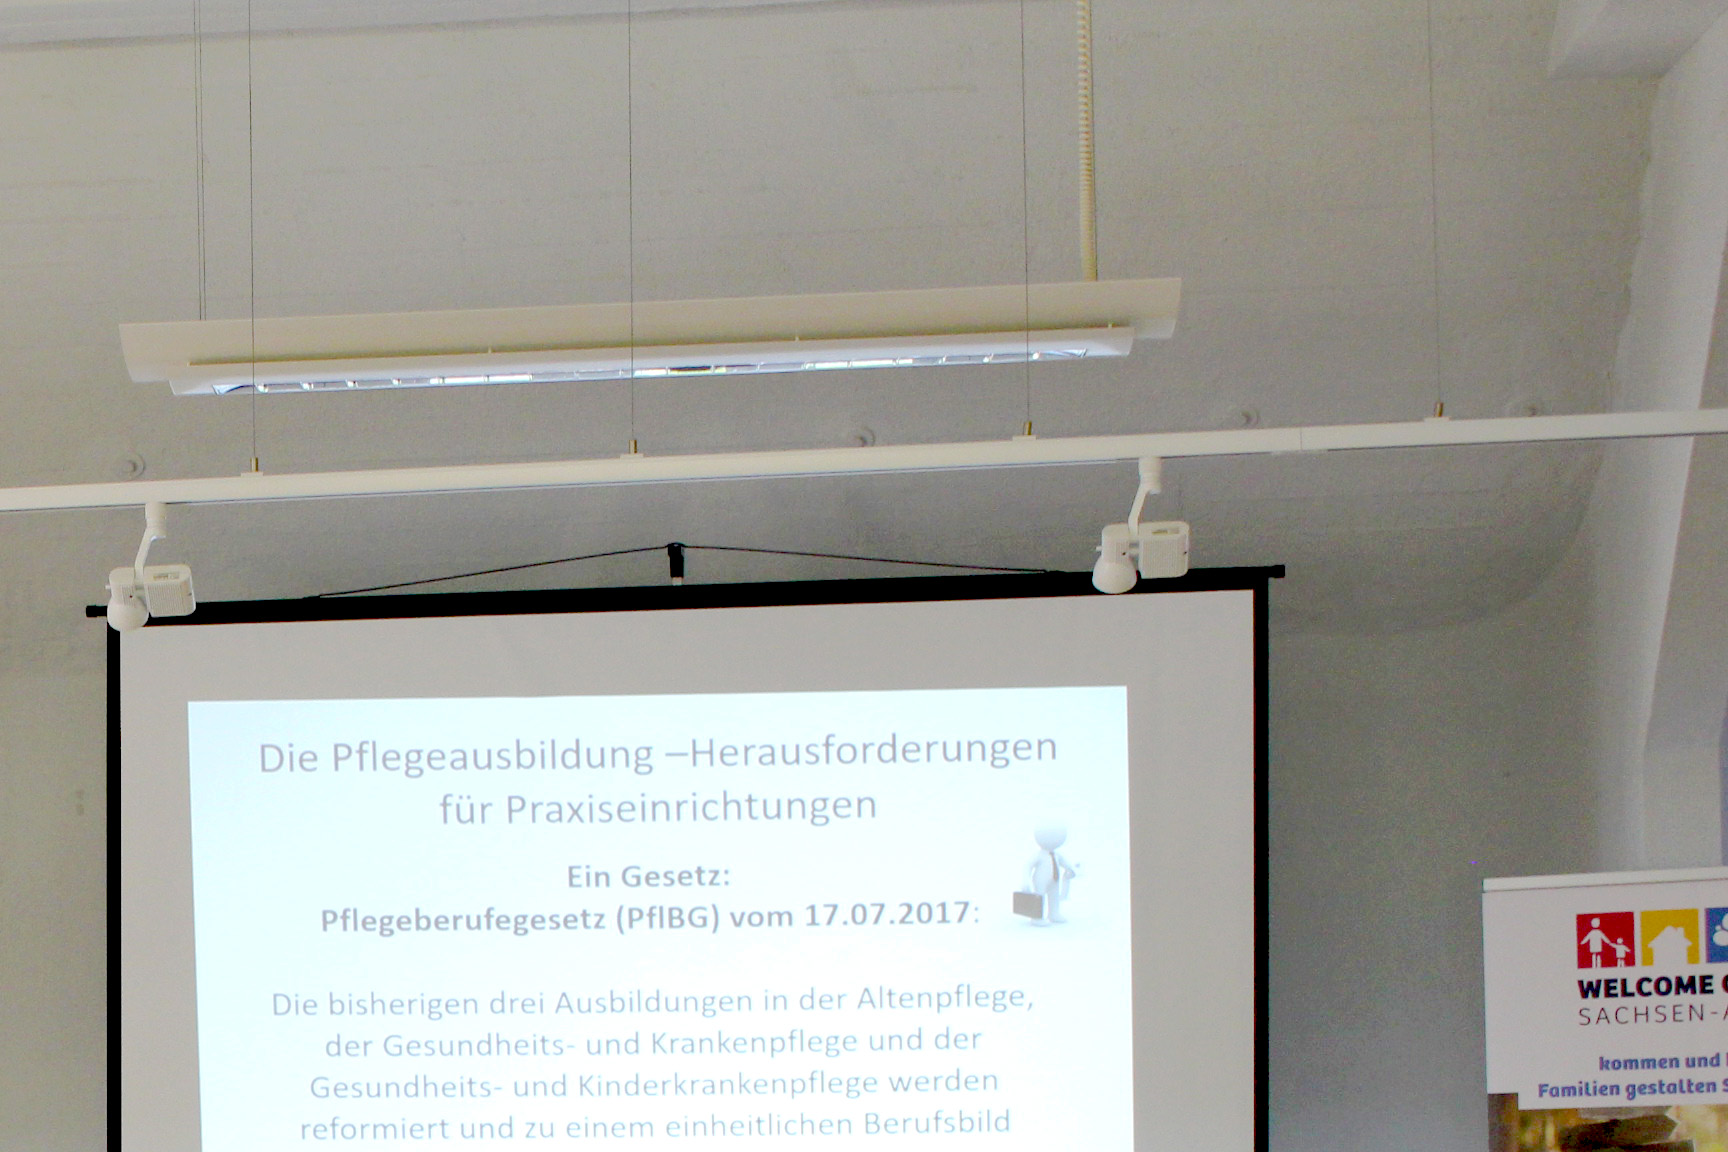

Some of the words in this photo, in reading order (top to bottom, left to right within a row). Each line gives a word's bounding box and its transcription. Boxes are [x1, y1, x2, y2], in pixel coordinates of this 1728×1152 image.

[260, 742, 318, 773] Die
[333, 739, 653, 778] Pflegeausbildung
[439, 793, 493, 825] für
[508, 790, 876, 826] Praxiseinrichtungen
[568, 865, 610, 888] Ein
[621, 865, 730, 887] Gesetz:
[322, 908, 606, 937] Pflegeberufegesetz
[730, 908, 793, 928] vom
[805, 901, 980, 927] 17.07.2017:
[1577, 974, 1714, 999] WELCOME
[273, 993, 318, 1016] Die
[329, 991, 478, 1021] bisherigen
[489, 990, 544, 1014] drei
[555, 989, 751, 1018] Ausbildungen
[764, 988, 788, 1011] in
[799, 987, 847, 1010] der
[857, 984, 1034, 1013] Altenpflege,
[325, 1033, 373, 1057] der
[383, 1032, 575, 1057] Gesundheits-
[586, 1031, 639, 1056] und
[652, 1030, 858, 1058] Krankenpflege
[869, 1027, 923, 1052] und
[934, 1026, 983, 1051] der
[1599, 1054, 1680, 1071] kommen
[1685, 1053, 1720, 1068] und
[310, 1074, 503, 1099] Gesundheits-
[514, 1073, 567, 1098] und
[579, 1070, 878, 1099] Kinderkrankenpflege
[889, 1068, 998, 1093] werden
[1538, 1081, 1620, 1098] Familien
[1626, 1079, 1717, 1100] gestalten
[301, 1117, 449, 1140] reformiert
[460, 1116, 514, 1140] und
[525, 1121, 554, 1138] zu
[566, 1117, 654, 1139] einem
[666, 1112, 852, 1137] einheitlichen
[865, 1109, 1011, 1135] Berufsbild
